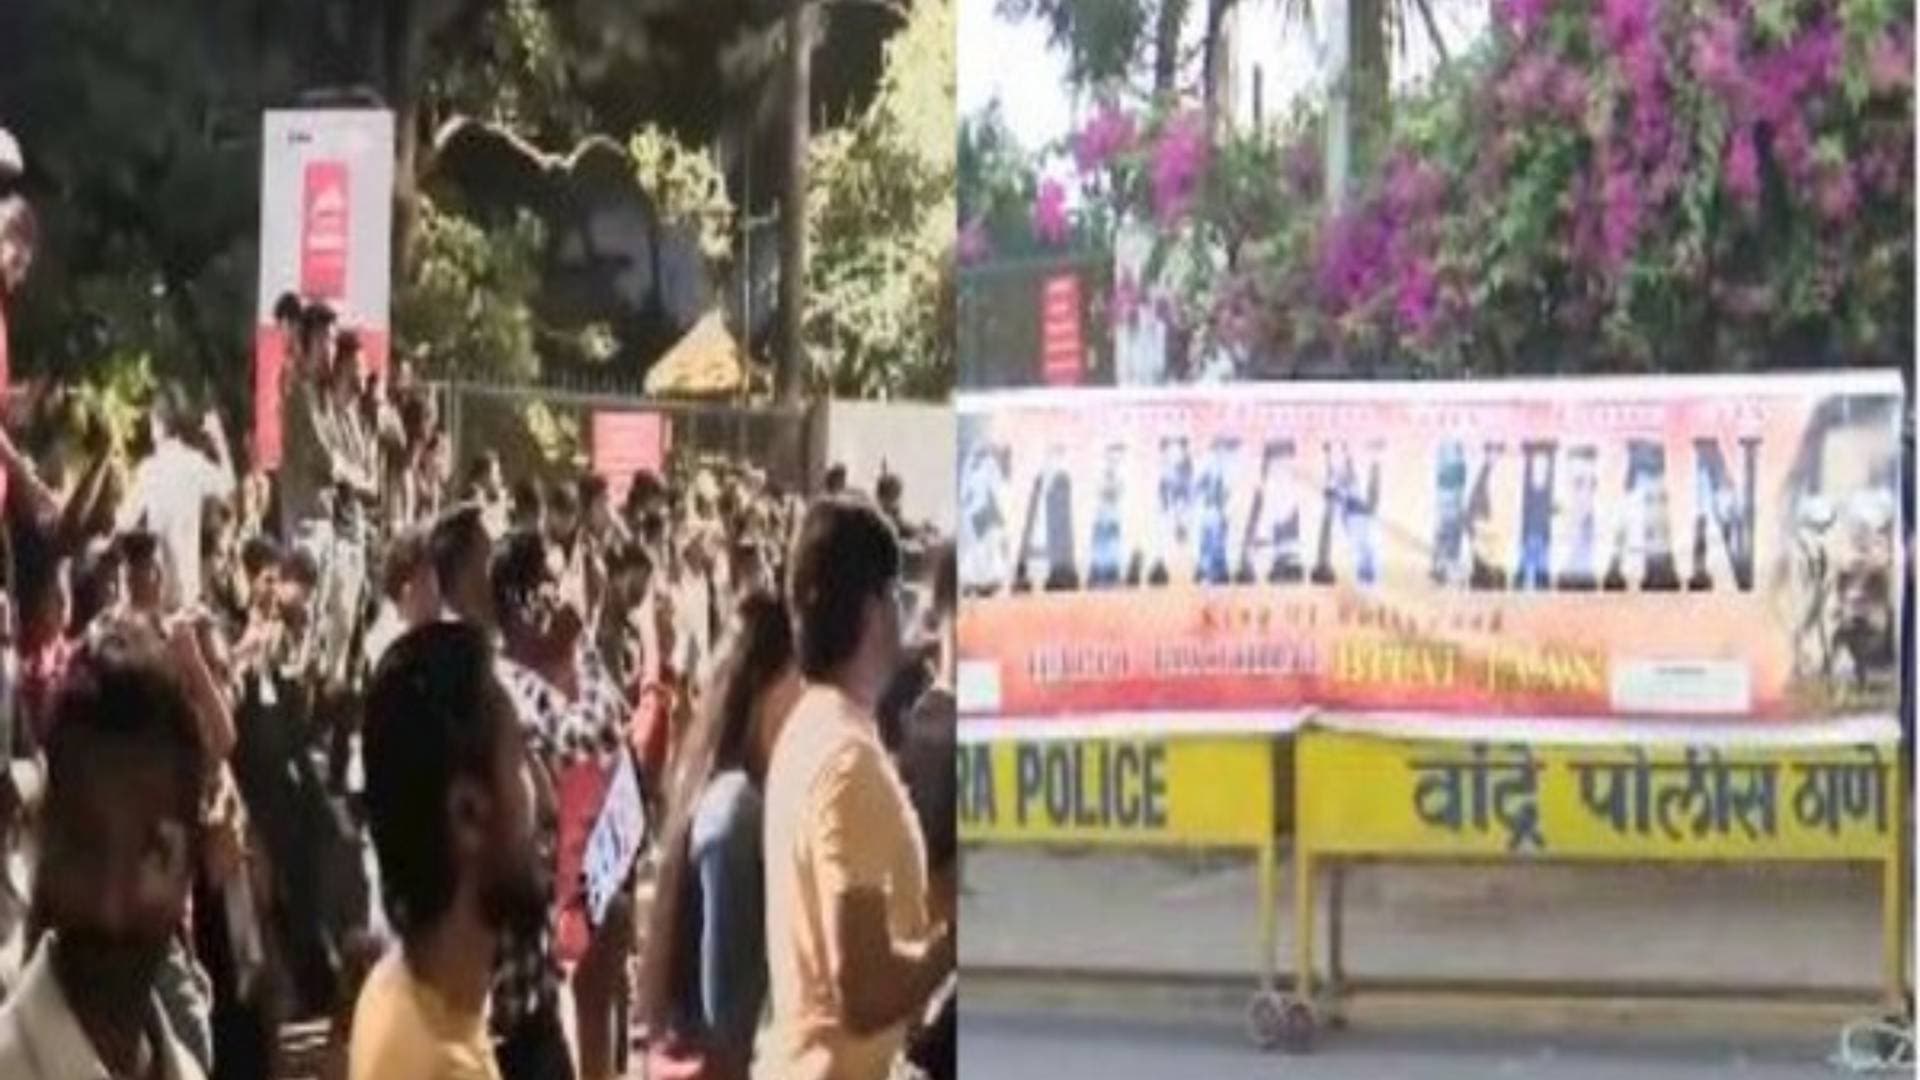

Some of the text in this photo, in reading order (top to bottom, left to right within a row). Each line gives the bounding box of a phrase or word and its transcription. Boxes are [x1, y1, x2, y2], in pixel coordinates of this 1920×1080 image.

[957, 434, 1762, 596] SALMAN KHAN
[1016, 740, 1167, 828] POLICE
[1406, 743, 1891, 850] वांद्रे पोलीस ठाणे
